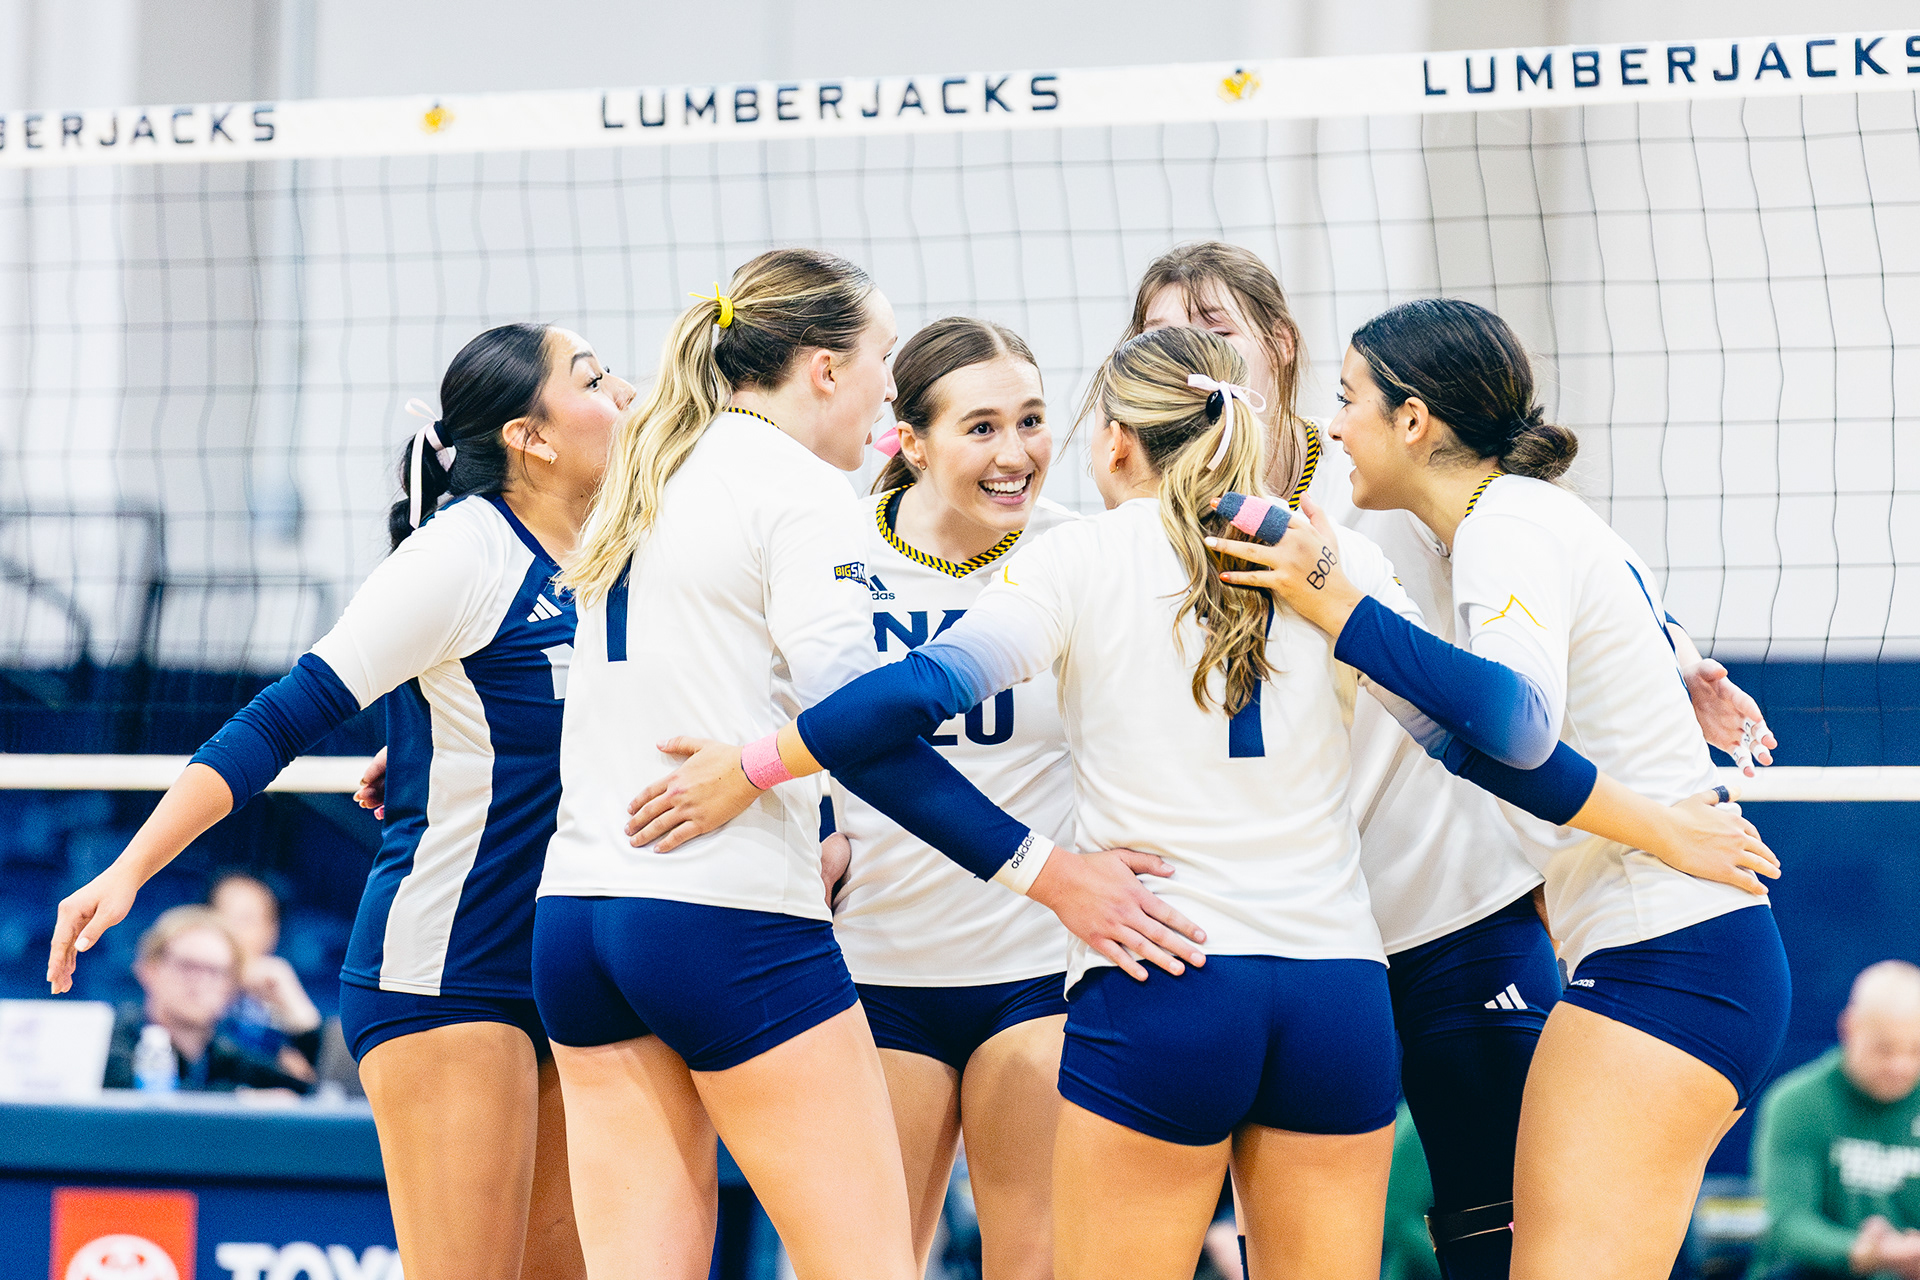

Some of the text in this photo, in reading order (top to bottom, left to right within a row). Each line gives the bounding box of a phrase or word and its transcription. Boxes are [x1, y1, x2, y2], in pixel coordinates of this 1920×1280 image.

[602, 75, 1060, 128] LUMBERJACKS
[1306, 545, 1338, 590] BOB
[1011, 835, 1035, 869] adidas
[214, 1241, 404, 1280] TOY
